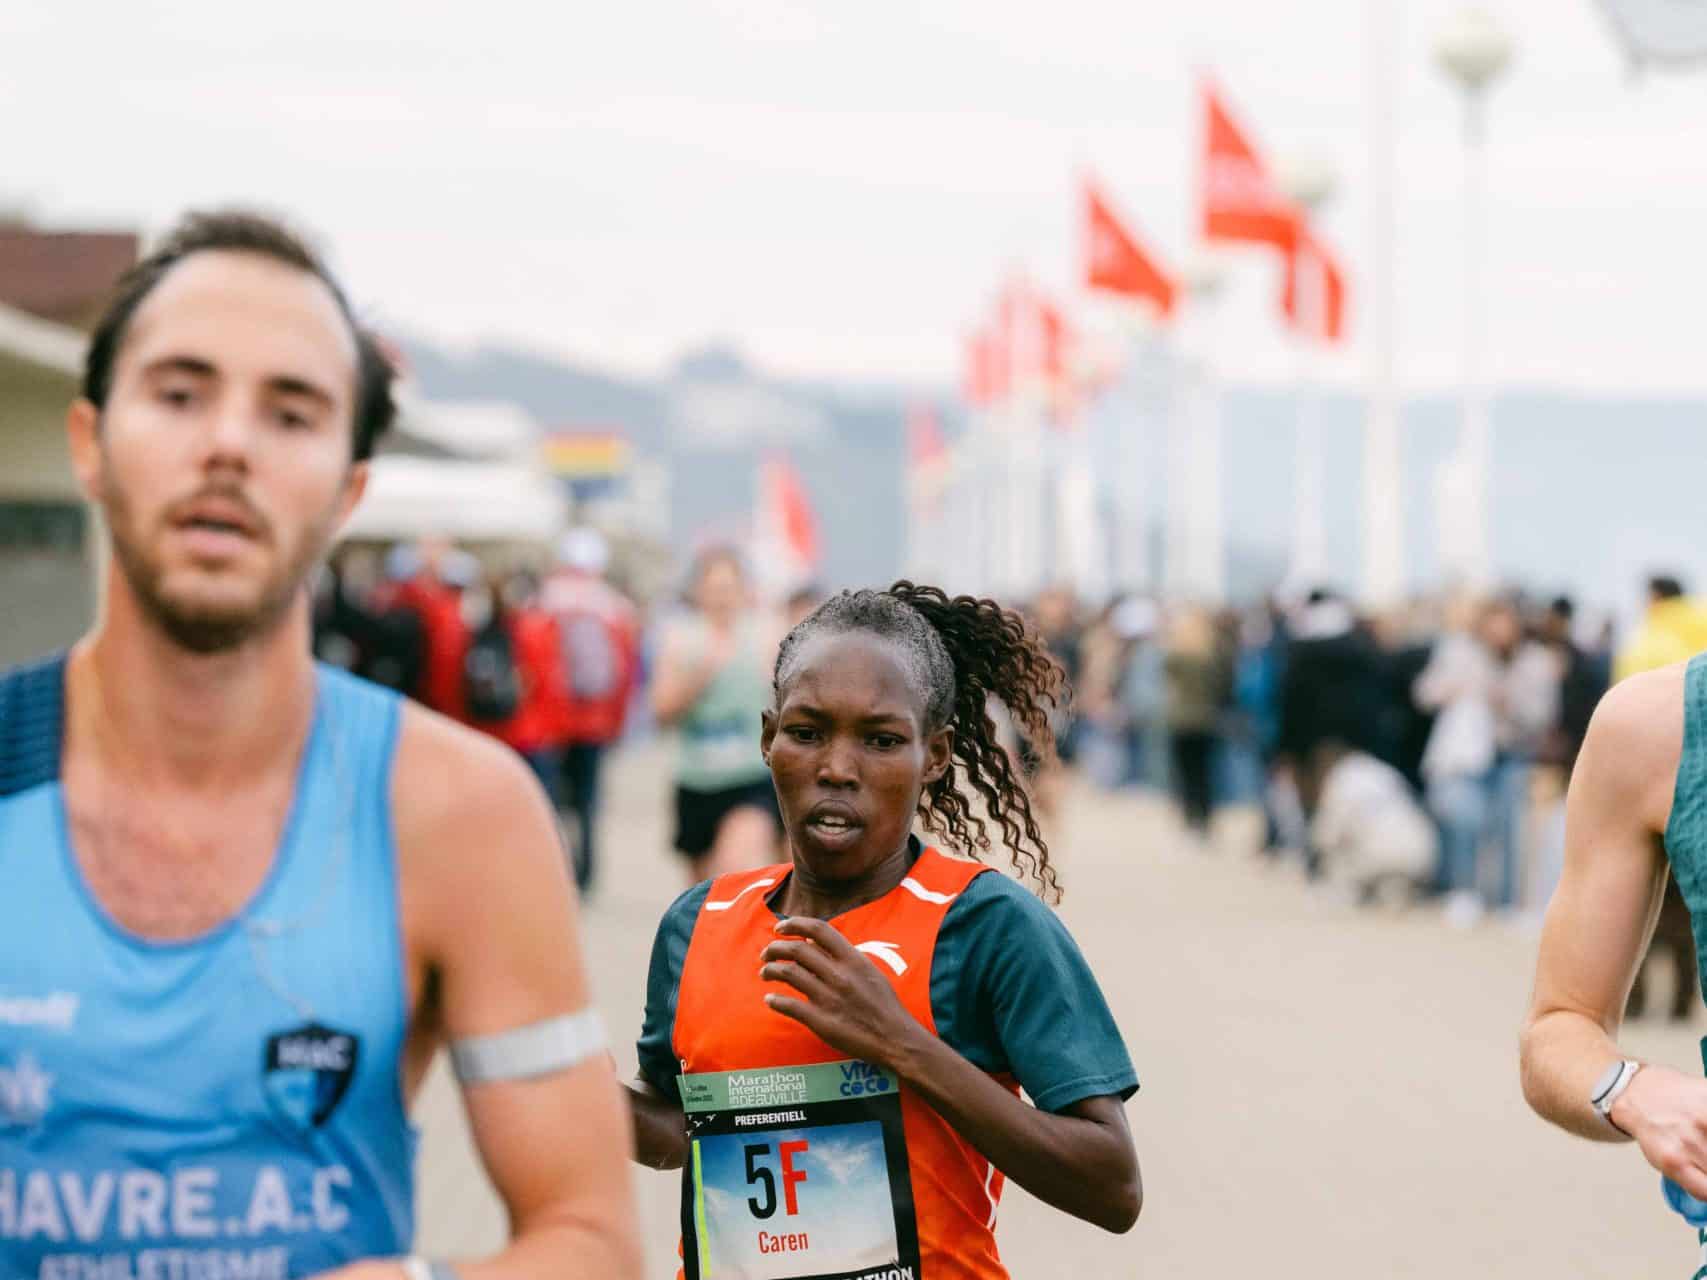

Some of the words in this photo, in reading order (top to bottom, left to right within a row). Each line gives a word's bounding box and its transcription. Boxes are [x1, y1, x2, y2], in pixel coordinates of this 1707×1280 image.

[728, 1072, 806, 1088] Marathon
[839, 1078, 890, 1096] COCO
[744, 1139, 809, 1220] 5F
[758, 1230, 809, 1254] Caren
